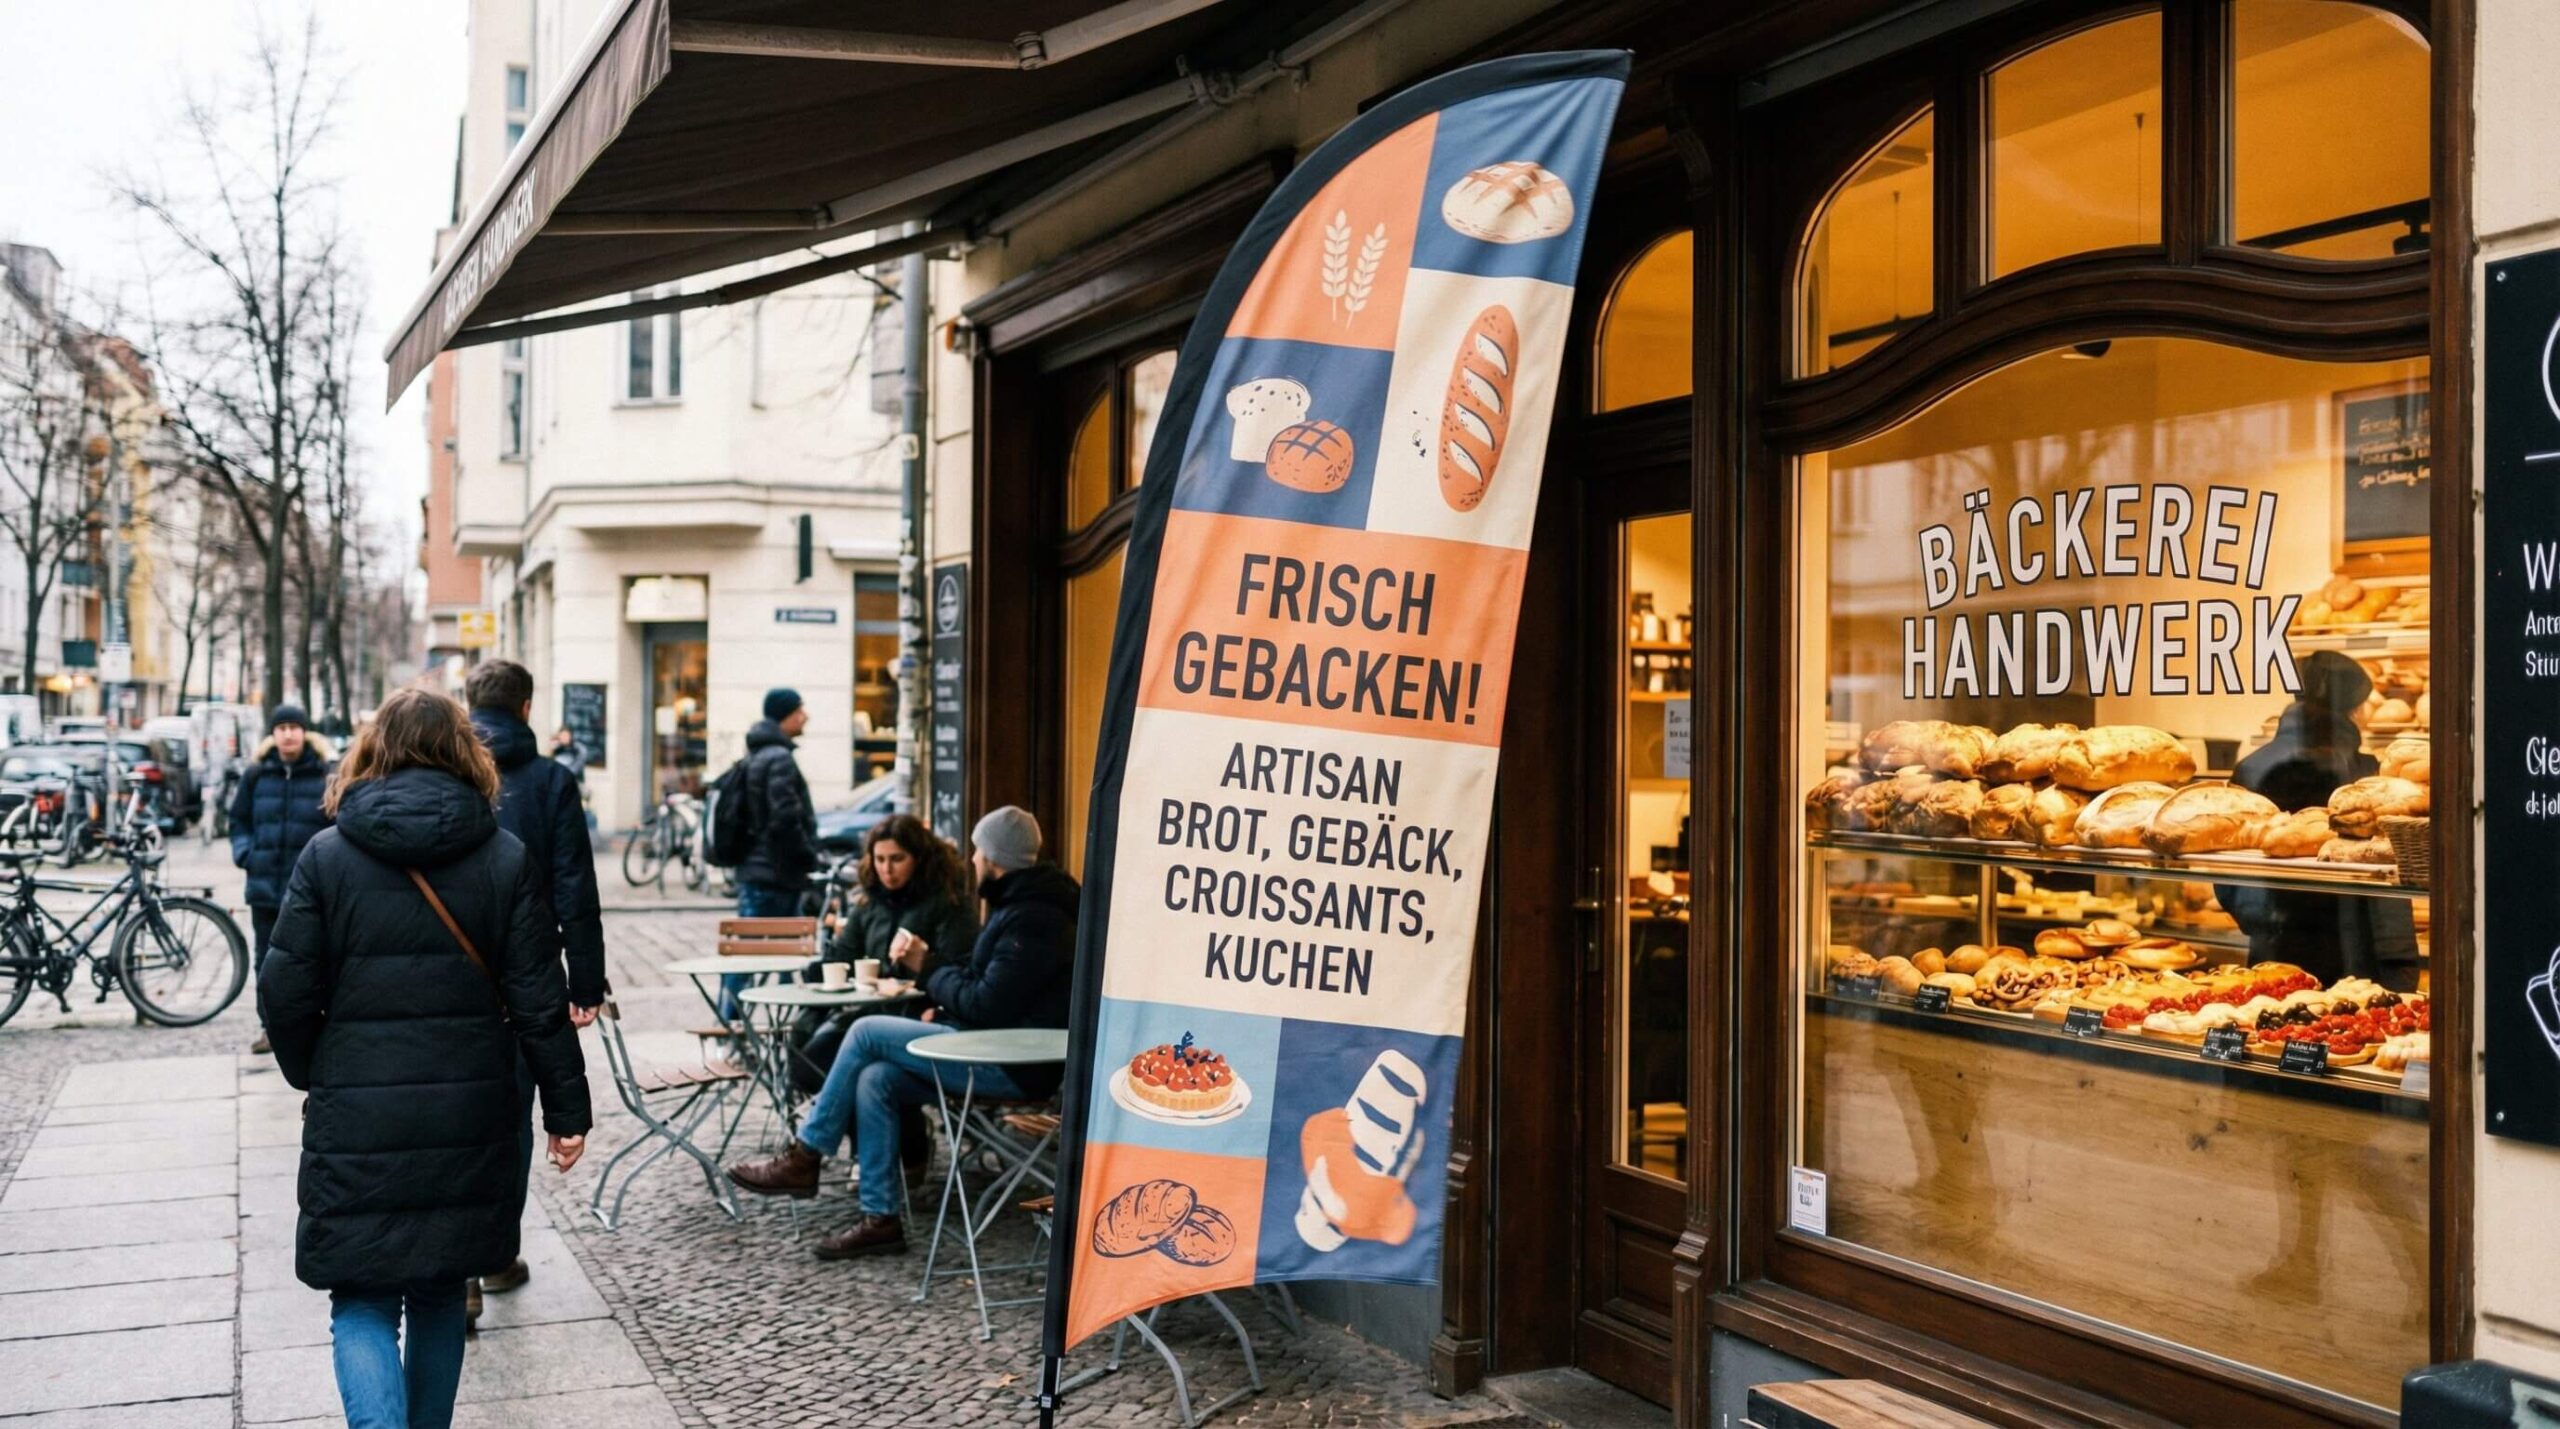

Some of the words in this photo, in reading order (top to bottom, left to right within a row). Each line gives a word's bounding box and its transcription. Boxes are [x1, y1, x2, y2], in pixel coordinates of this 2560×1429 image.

[1918, 483, 2279, 611] BÄCKEREI
[2523, 541, 2560, 590] W
[1236, 553, 1436, 636] FRISCH
[1173, 631, 1482, 726] GEBACKEN!
[1903, 594, 2302, 699] HANDWERK
[1220, 742, 1402, 807] ARTISAN
[1158, 798, 1270, 862] BROT,
[1288, 813, 1462, 883] GEBÄCK,
[1165, 864, 1434, 944] CROISSANTS,
[1205, 931, 1373, 996] KUCHEN
